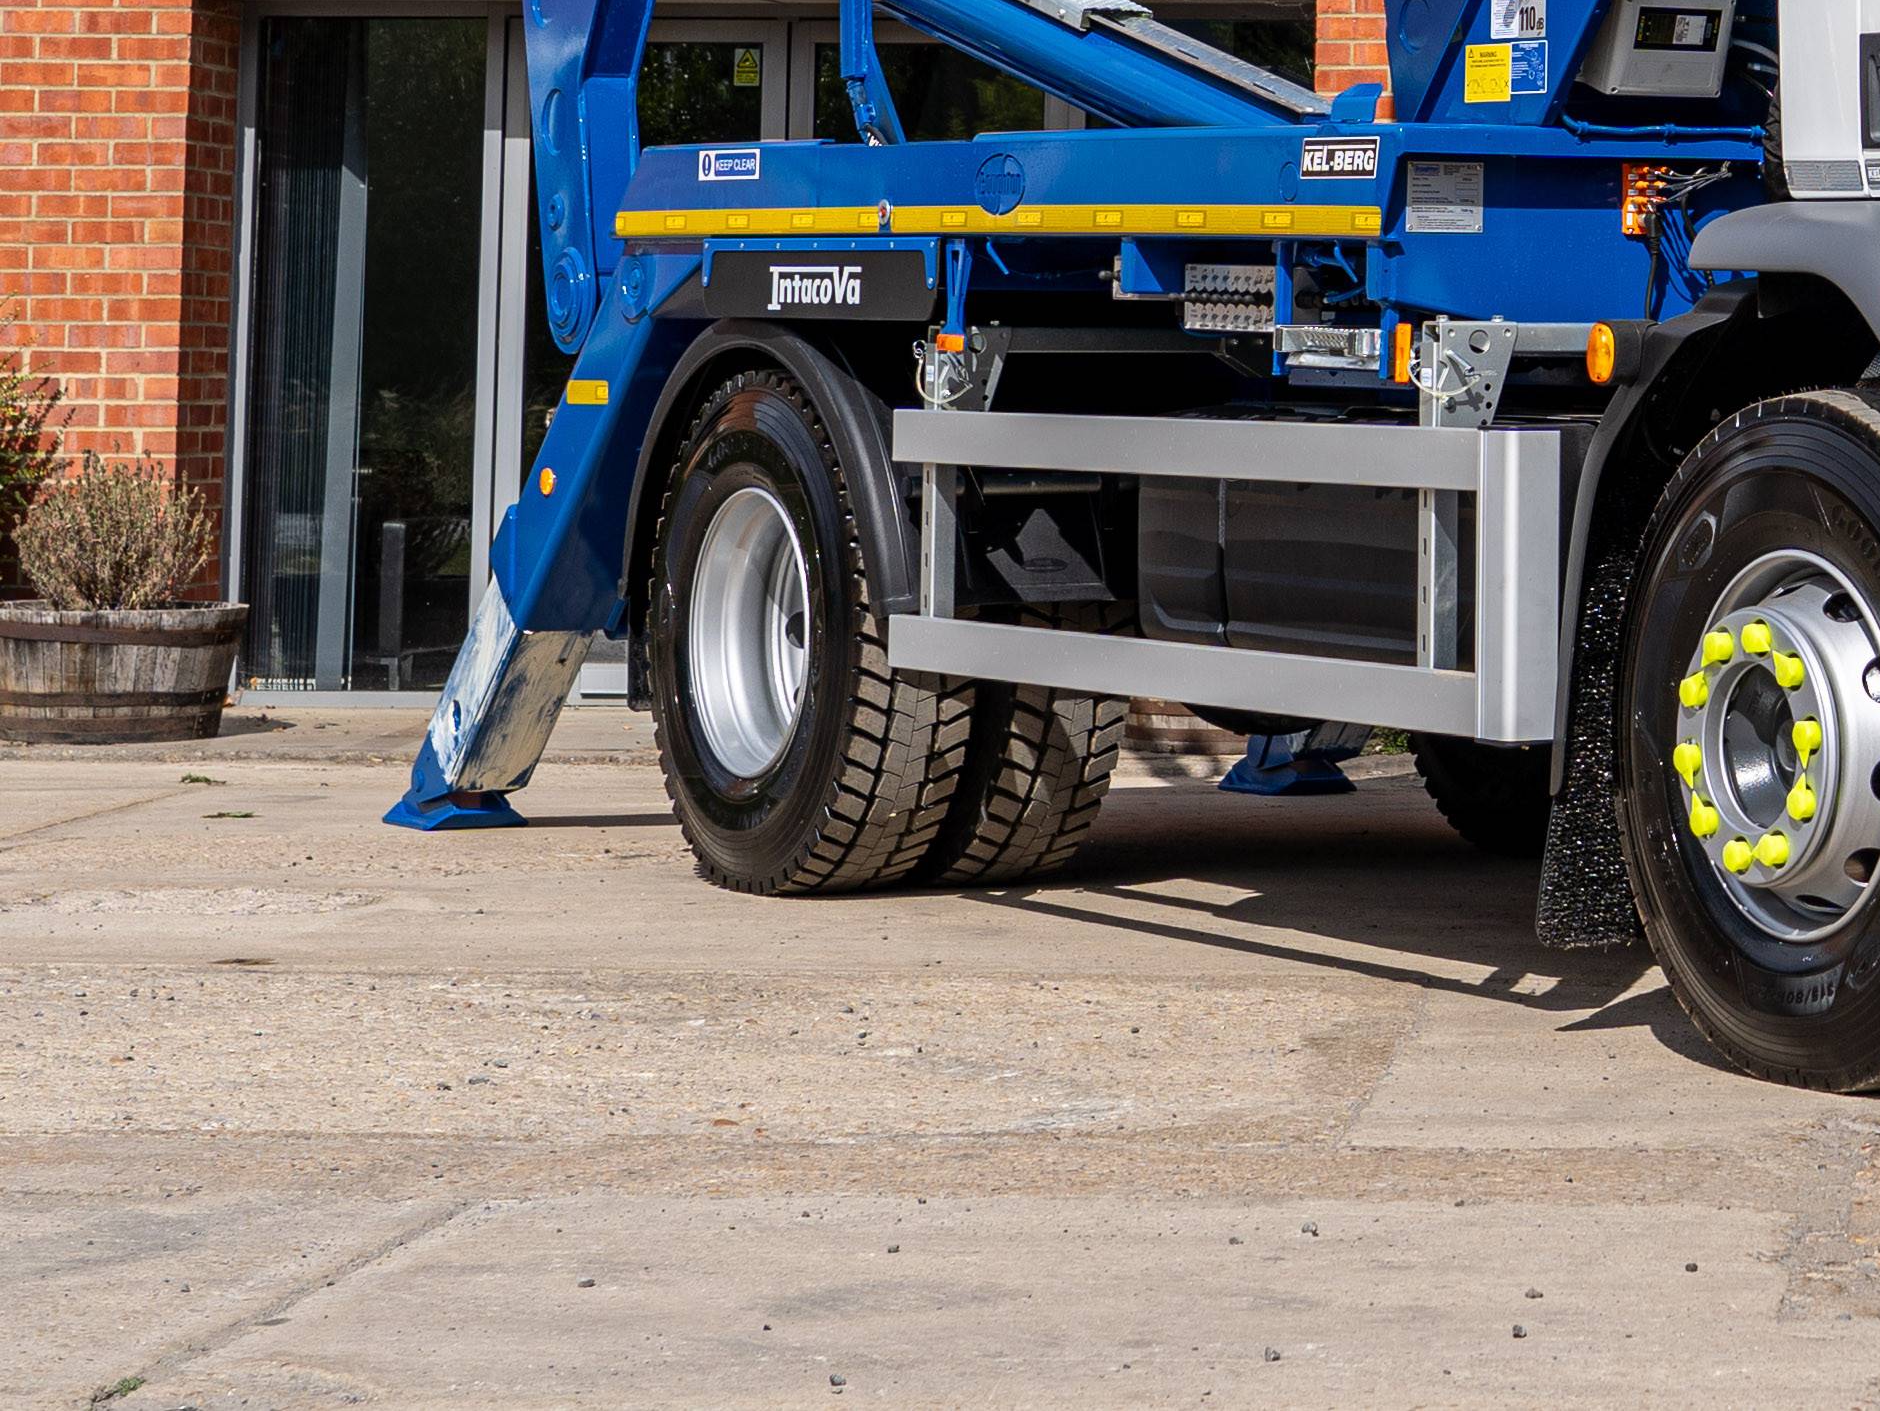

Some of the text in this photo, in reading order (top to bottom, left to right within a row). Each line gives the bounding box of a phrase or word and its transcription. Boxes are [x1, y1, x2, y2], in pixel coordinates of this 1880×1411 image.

[1519, 6, 1536, 31] 110
[715, 156, 756, 171] KEEP CLEAR
[1302, 145, 1375, 172] KEL-BERG
[767, 266, 862, 311] IntacoVa
